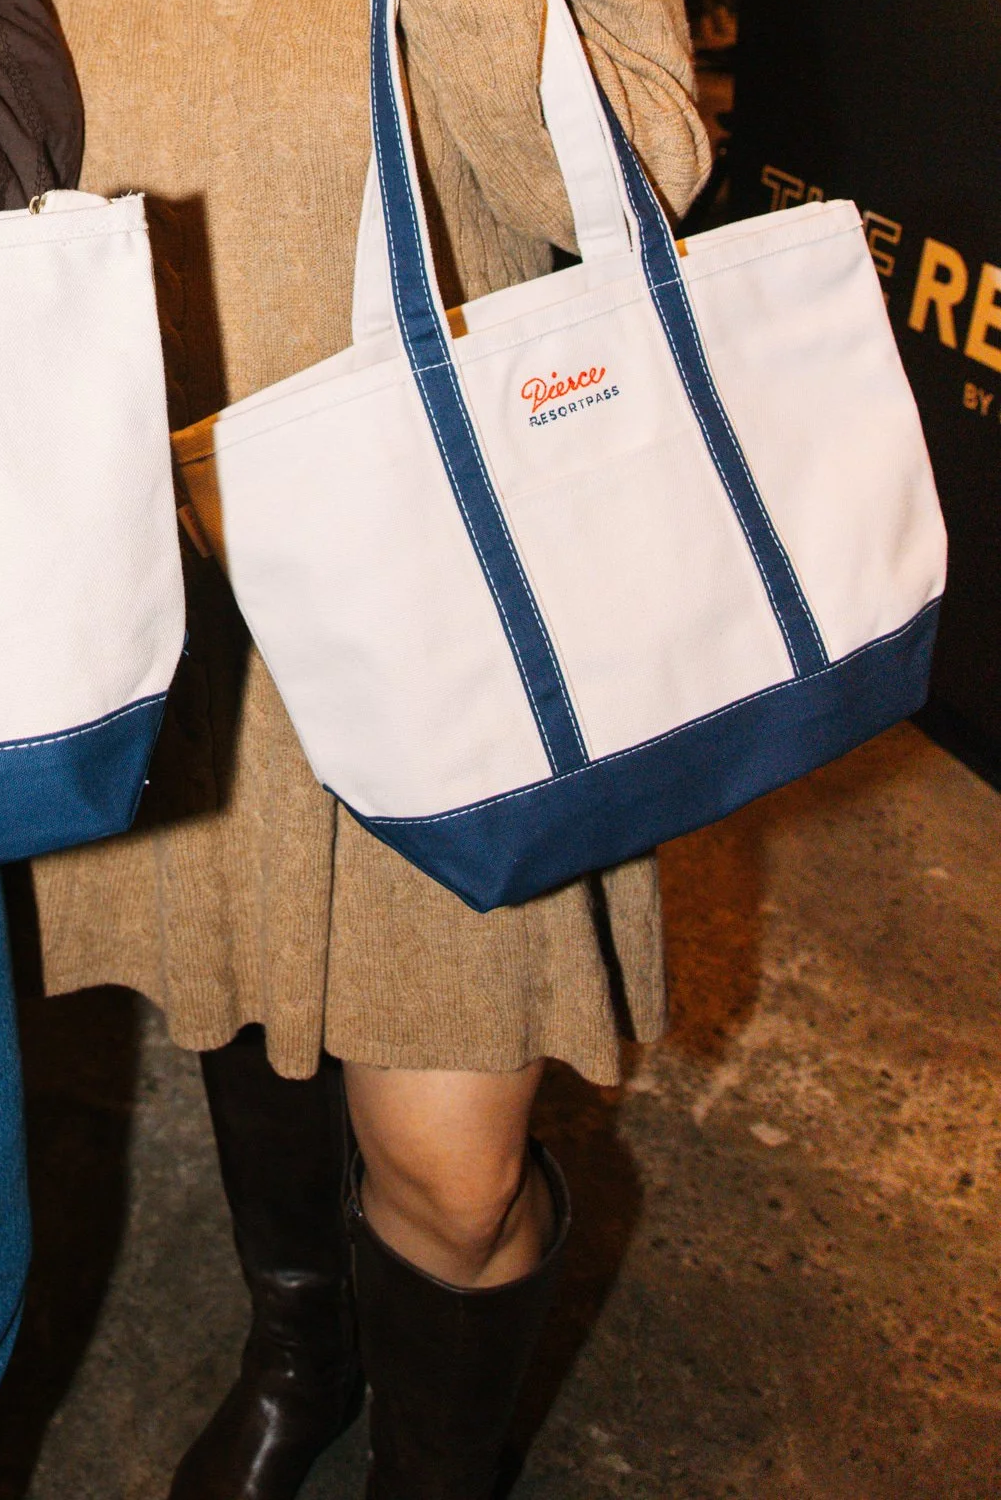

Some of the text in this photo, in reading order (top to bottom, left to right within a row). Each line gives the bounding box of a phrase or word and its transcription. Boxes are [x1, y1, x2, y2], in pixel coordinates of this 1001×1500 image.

[762, 164, 903, 277] TE
[529, 386, 620, 426] RESORTPASS
[963, 381, 994, 416] BY
